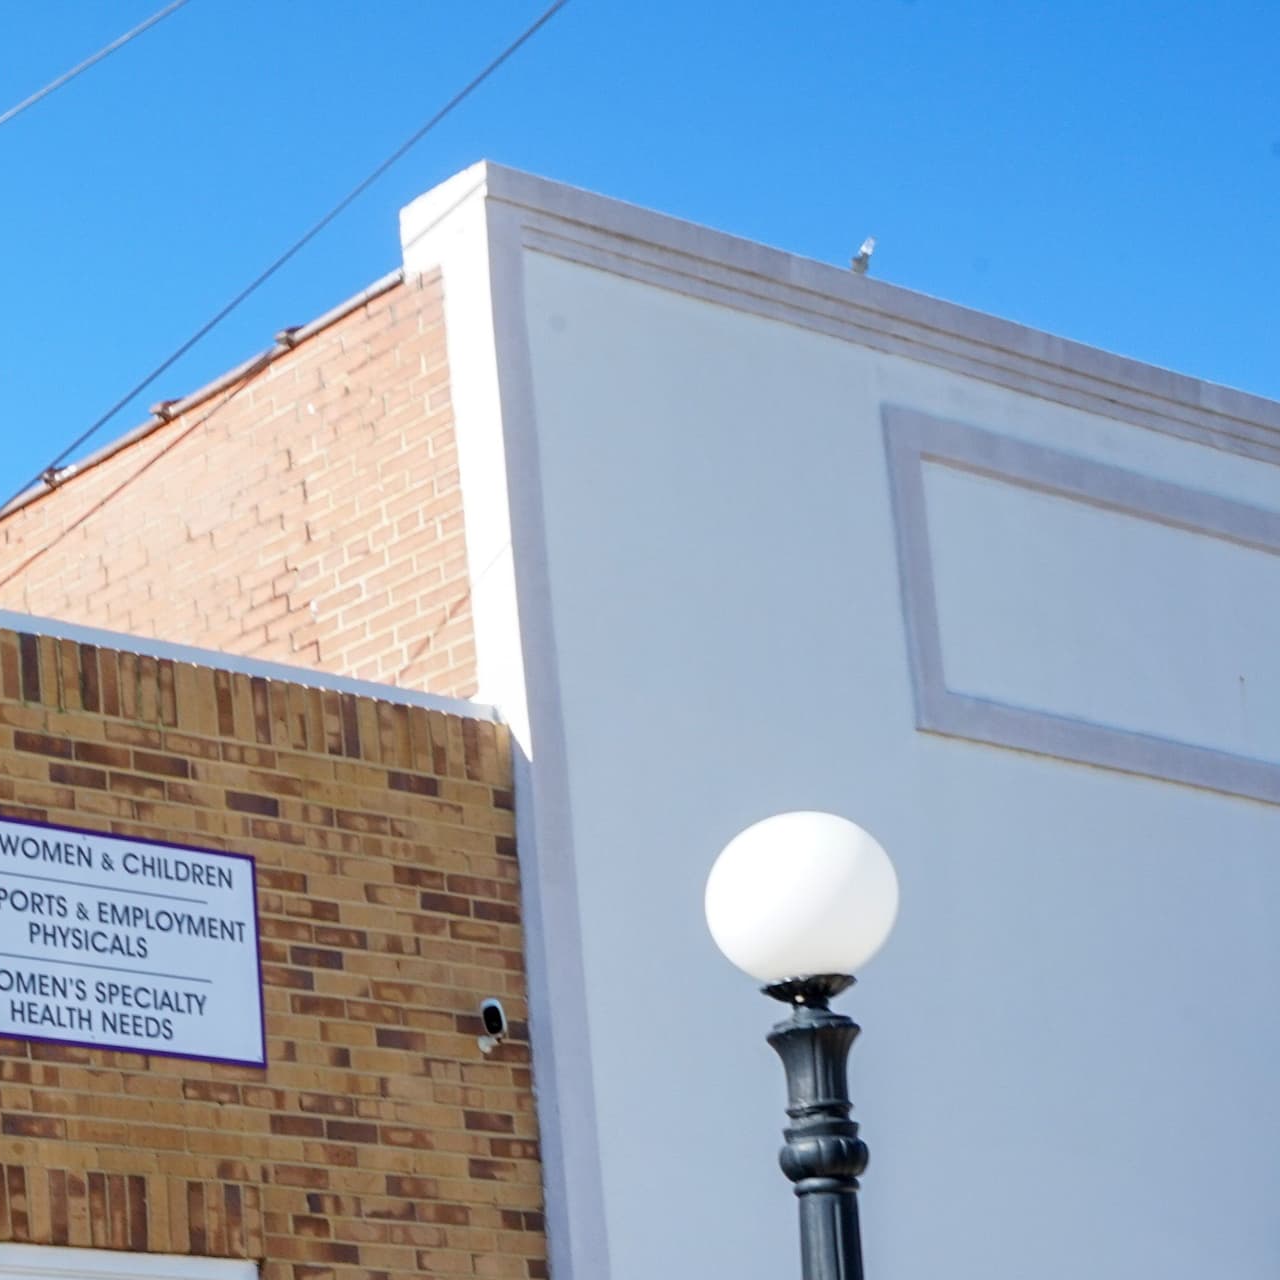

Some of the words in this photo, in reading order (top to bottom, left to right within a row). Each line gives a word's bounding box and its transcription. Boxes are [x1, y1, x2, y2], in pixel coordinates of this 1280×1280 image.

[101, 853, 115, 871] &
[122, 852, 233, 889] CHILDREN
[28, 922, 148, 959] PHYSICALS
[76, 903, 90, 921] &
[98, 902, 246, 943] EMPLOYMENT
[95, 982, 207, 1016] SPECIALTY
[10, 1000, 92, 1032] HEALTH
[101, 1012, 174, 1041] NEEDS
